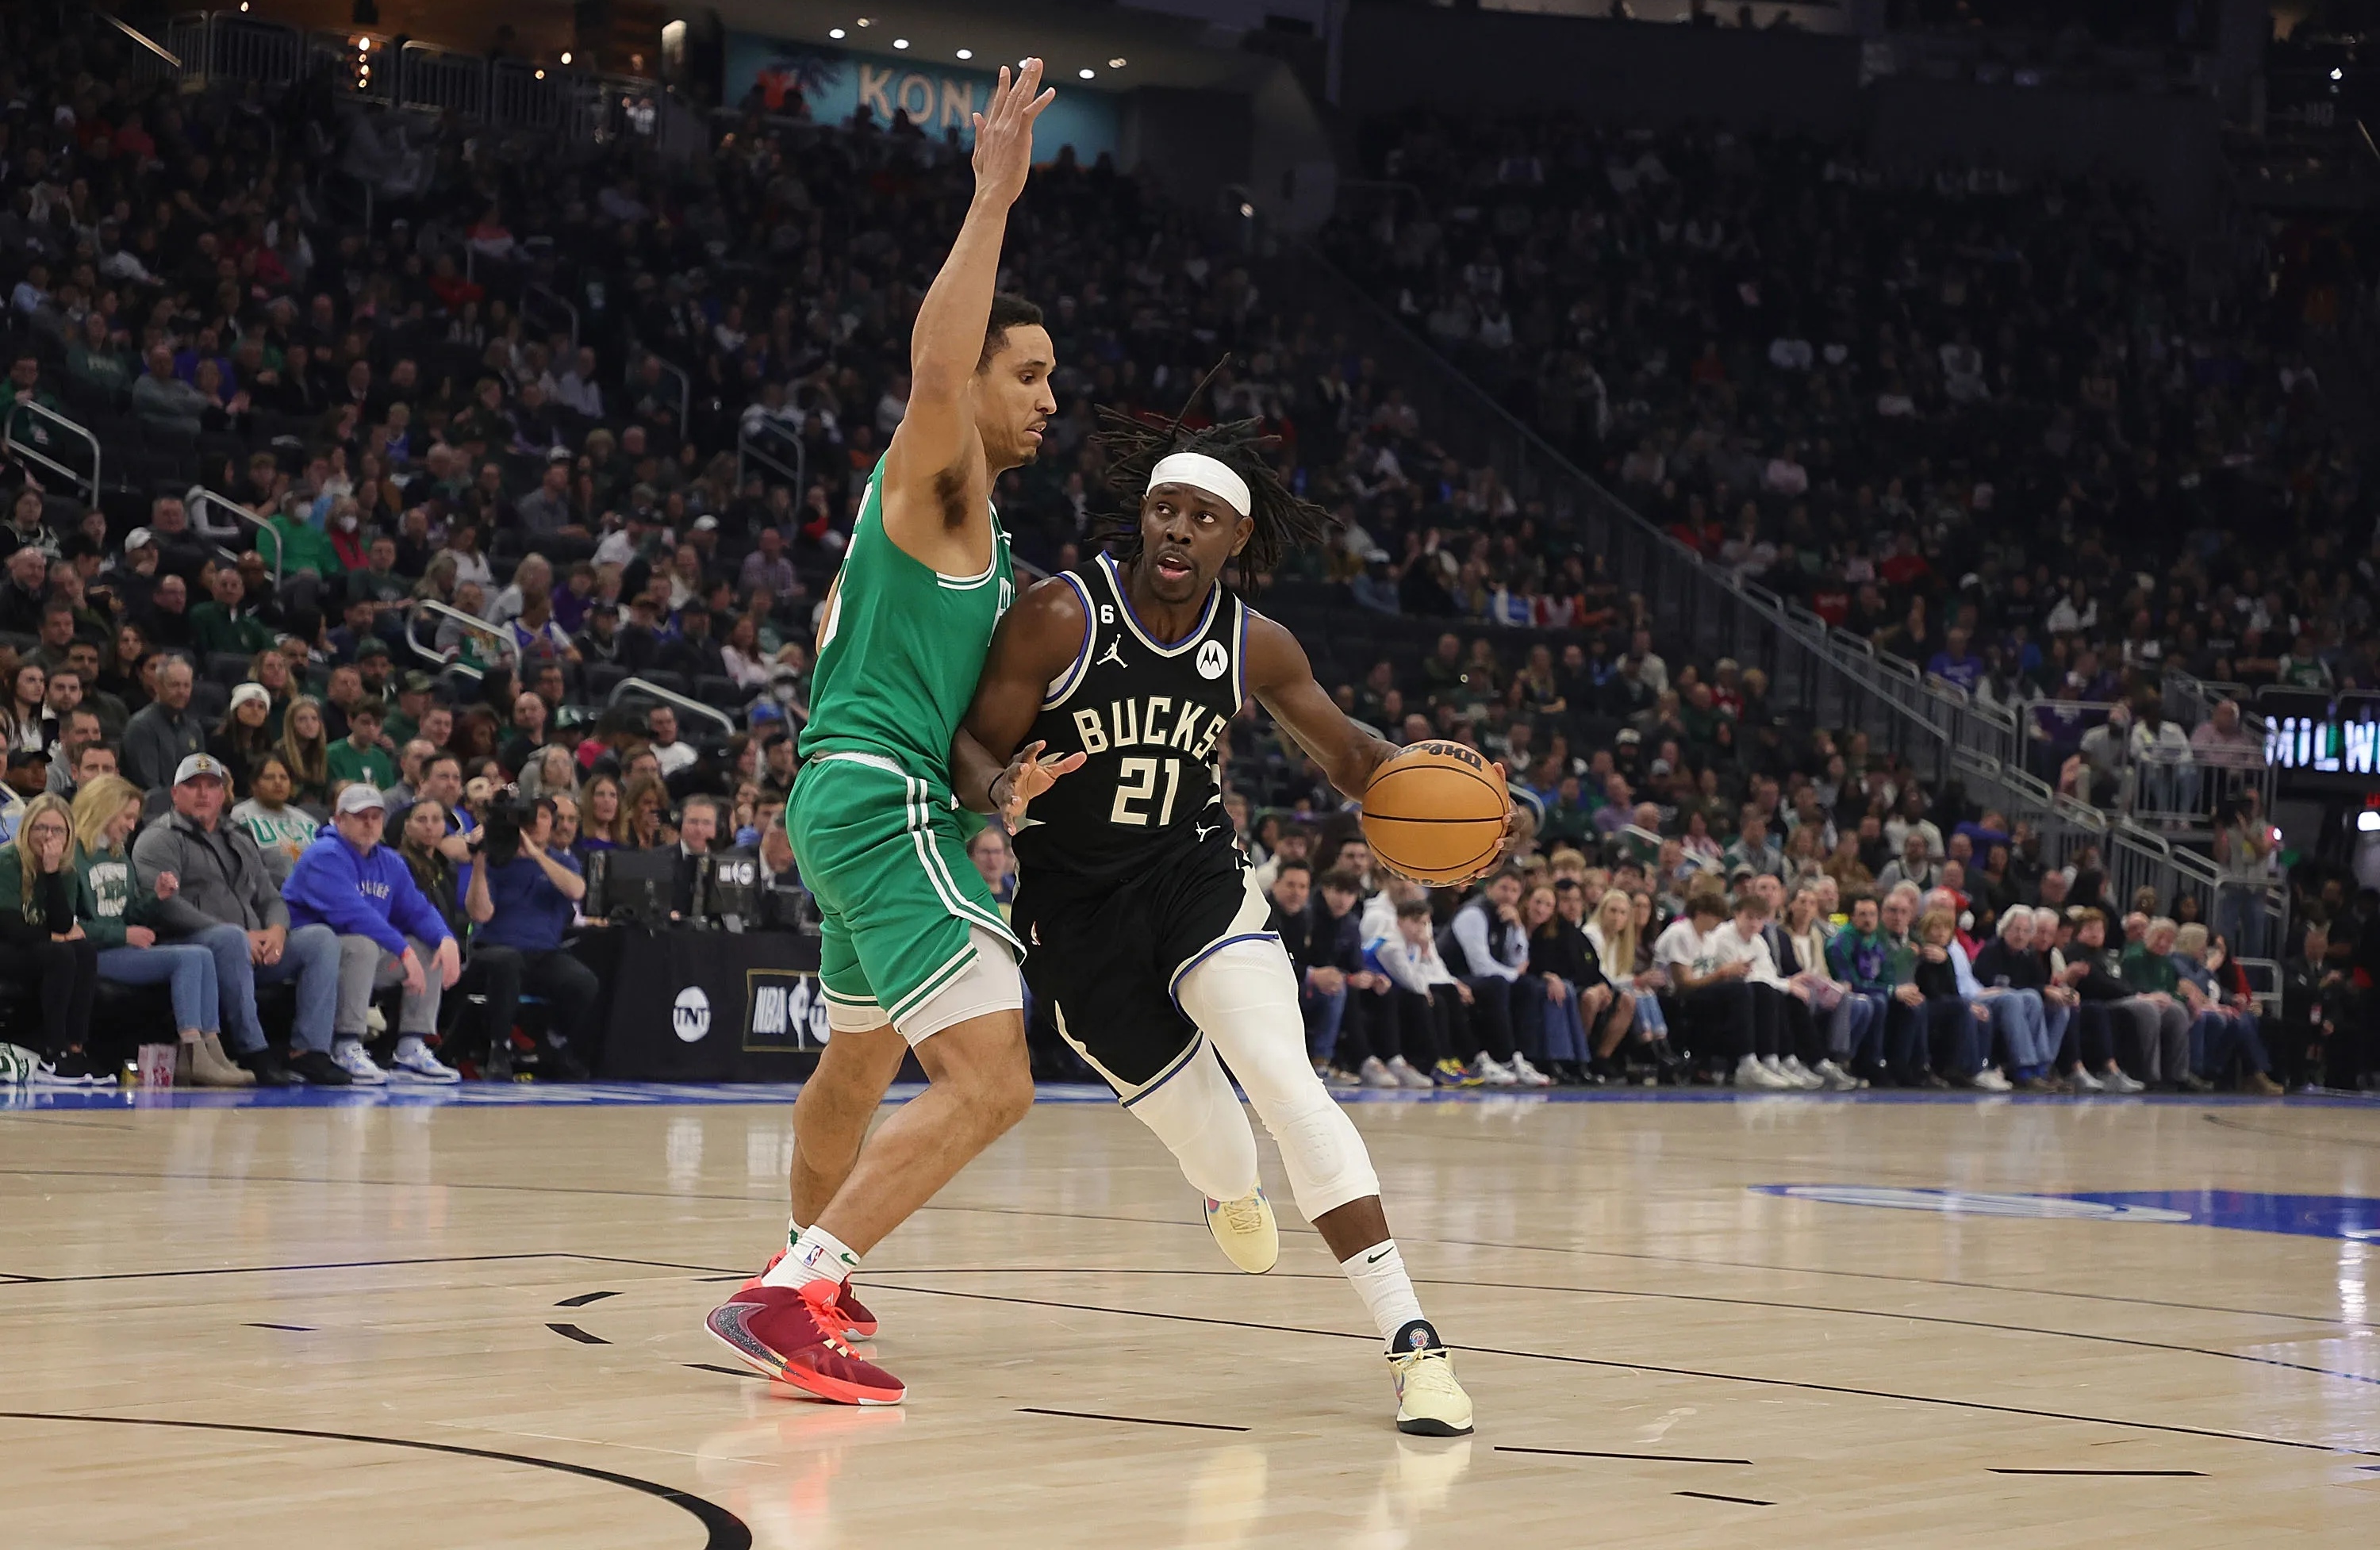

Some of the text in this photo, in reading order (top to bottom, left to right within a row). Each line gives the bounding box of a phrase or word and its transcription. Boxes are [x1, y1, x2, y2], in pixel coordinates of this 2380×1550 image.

[858, 63, 1000, 129] KON
[1100, 604, 1115, 624] 6
[1073, 696, 1227, 761] BUCKS
[2265, 716, 2380, 774] MILW
[1111, 757, 1180, 827] 21
[753, 986, 787, 1034] NBA
